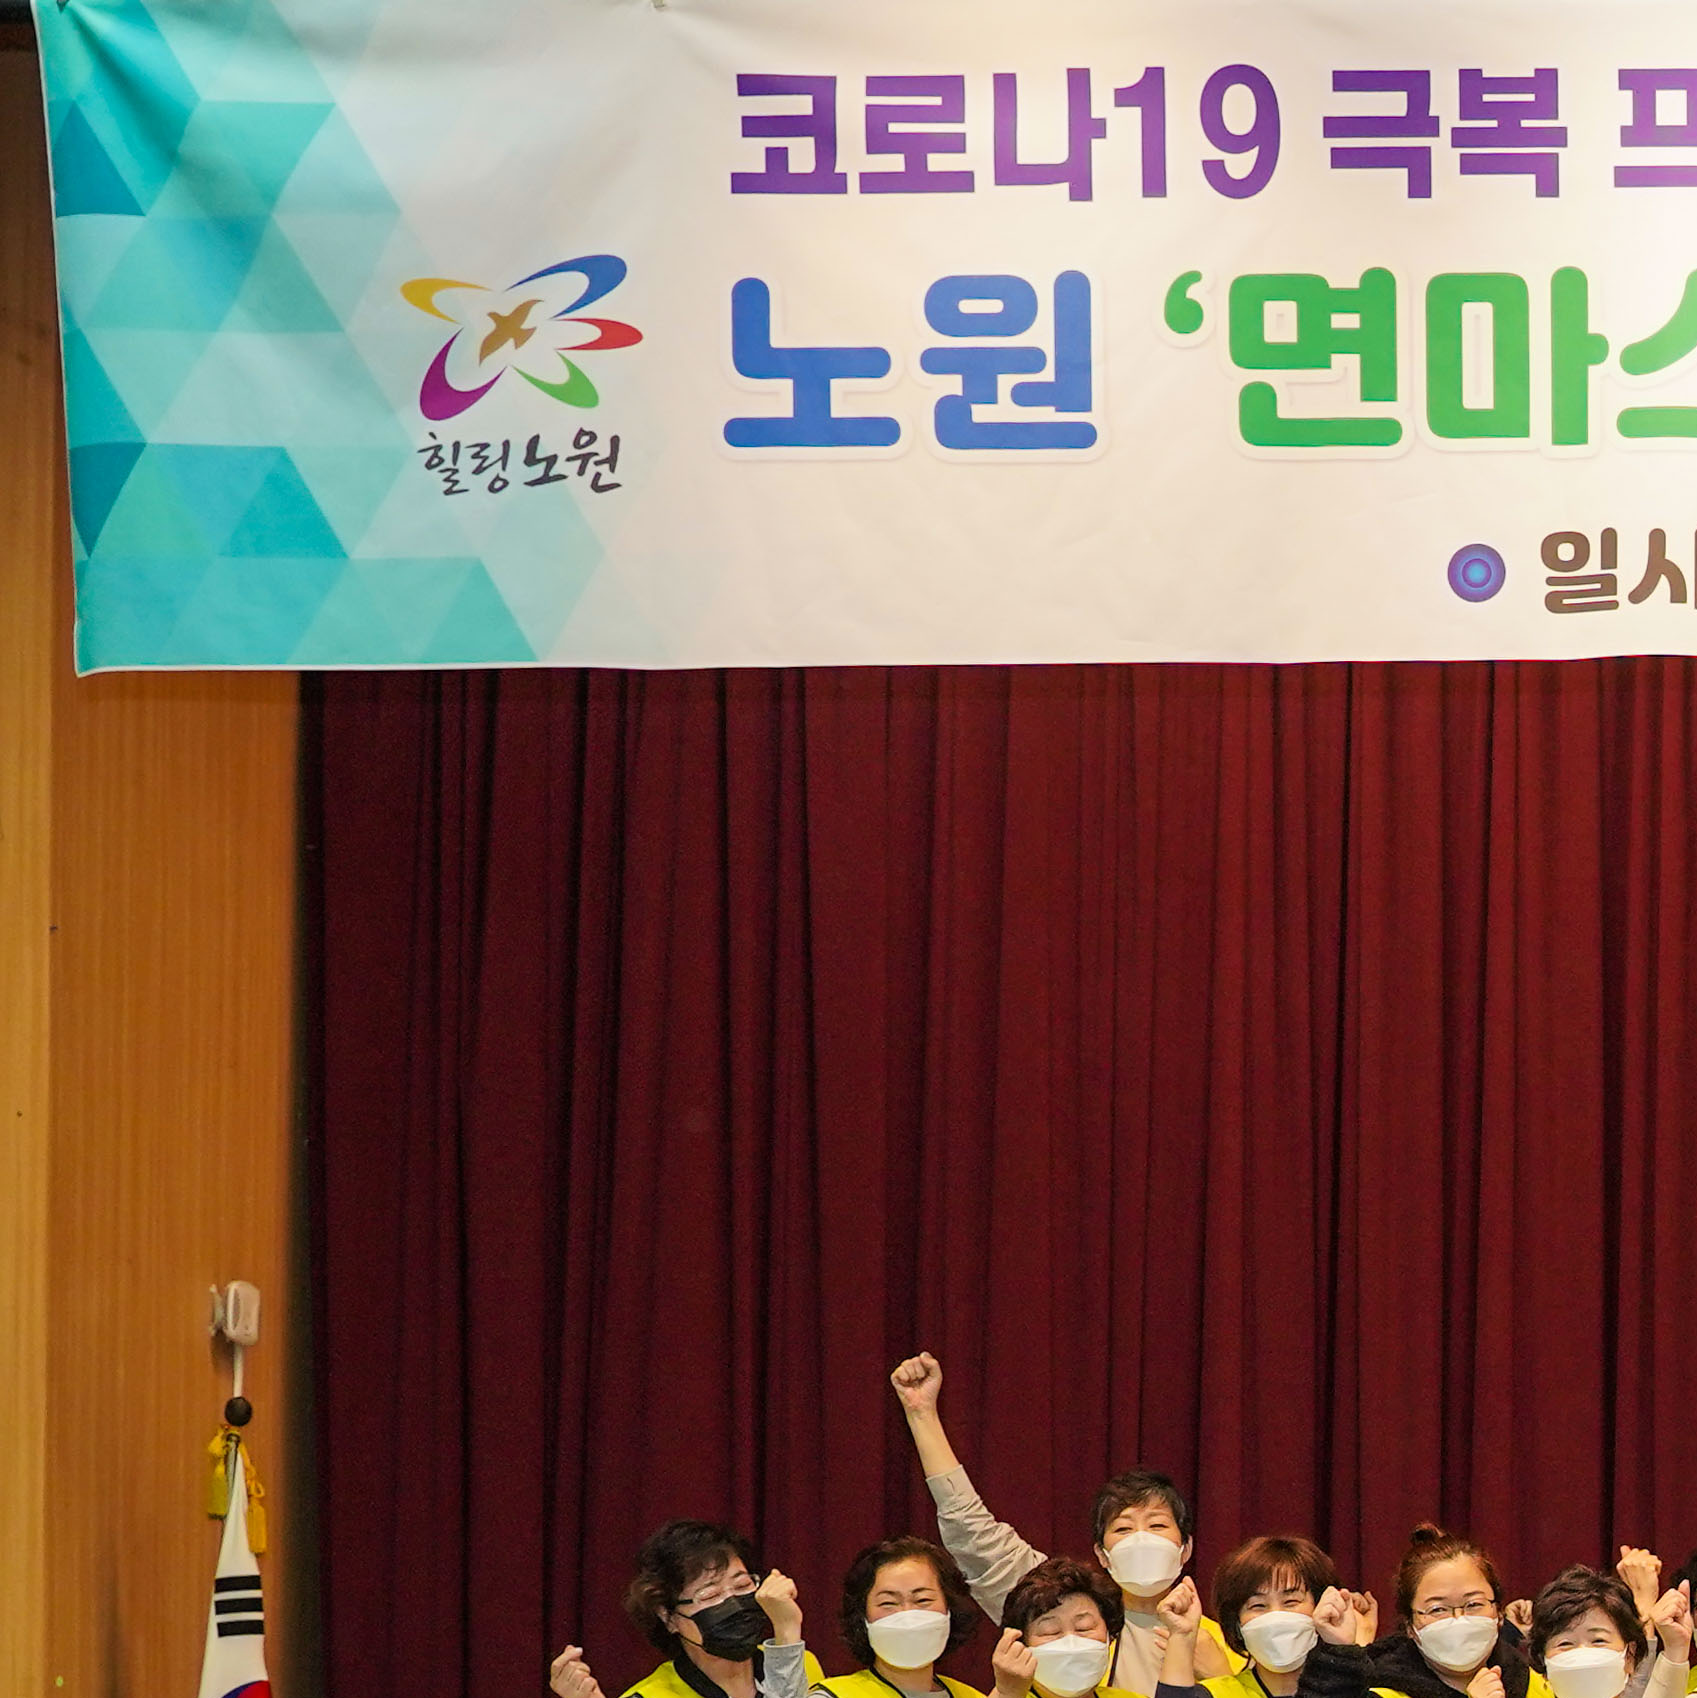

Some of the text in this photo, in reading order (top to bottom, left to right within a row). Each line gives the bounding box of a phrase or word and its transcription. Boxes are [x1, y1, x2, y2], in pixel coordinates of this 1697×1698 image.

[731, 64, 1280, 200] 코로나19
[1323, 69, 1564, 198] 극복
[724, 272, 1098, 450] 노원
